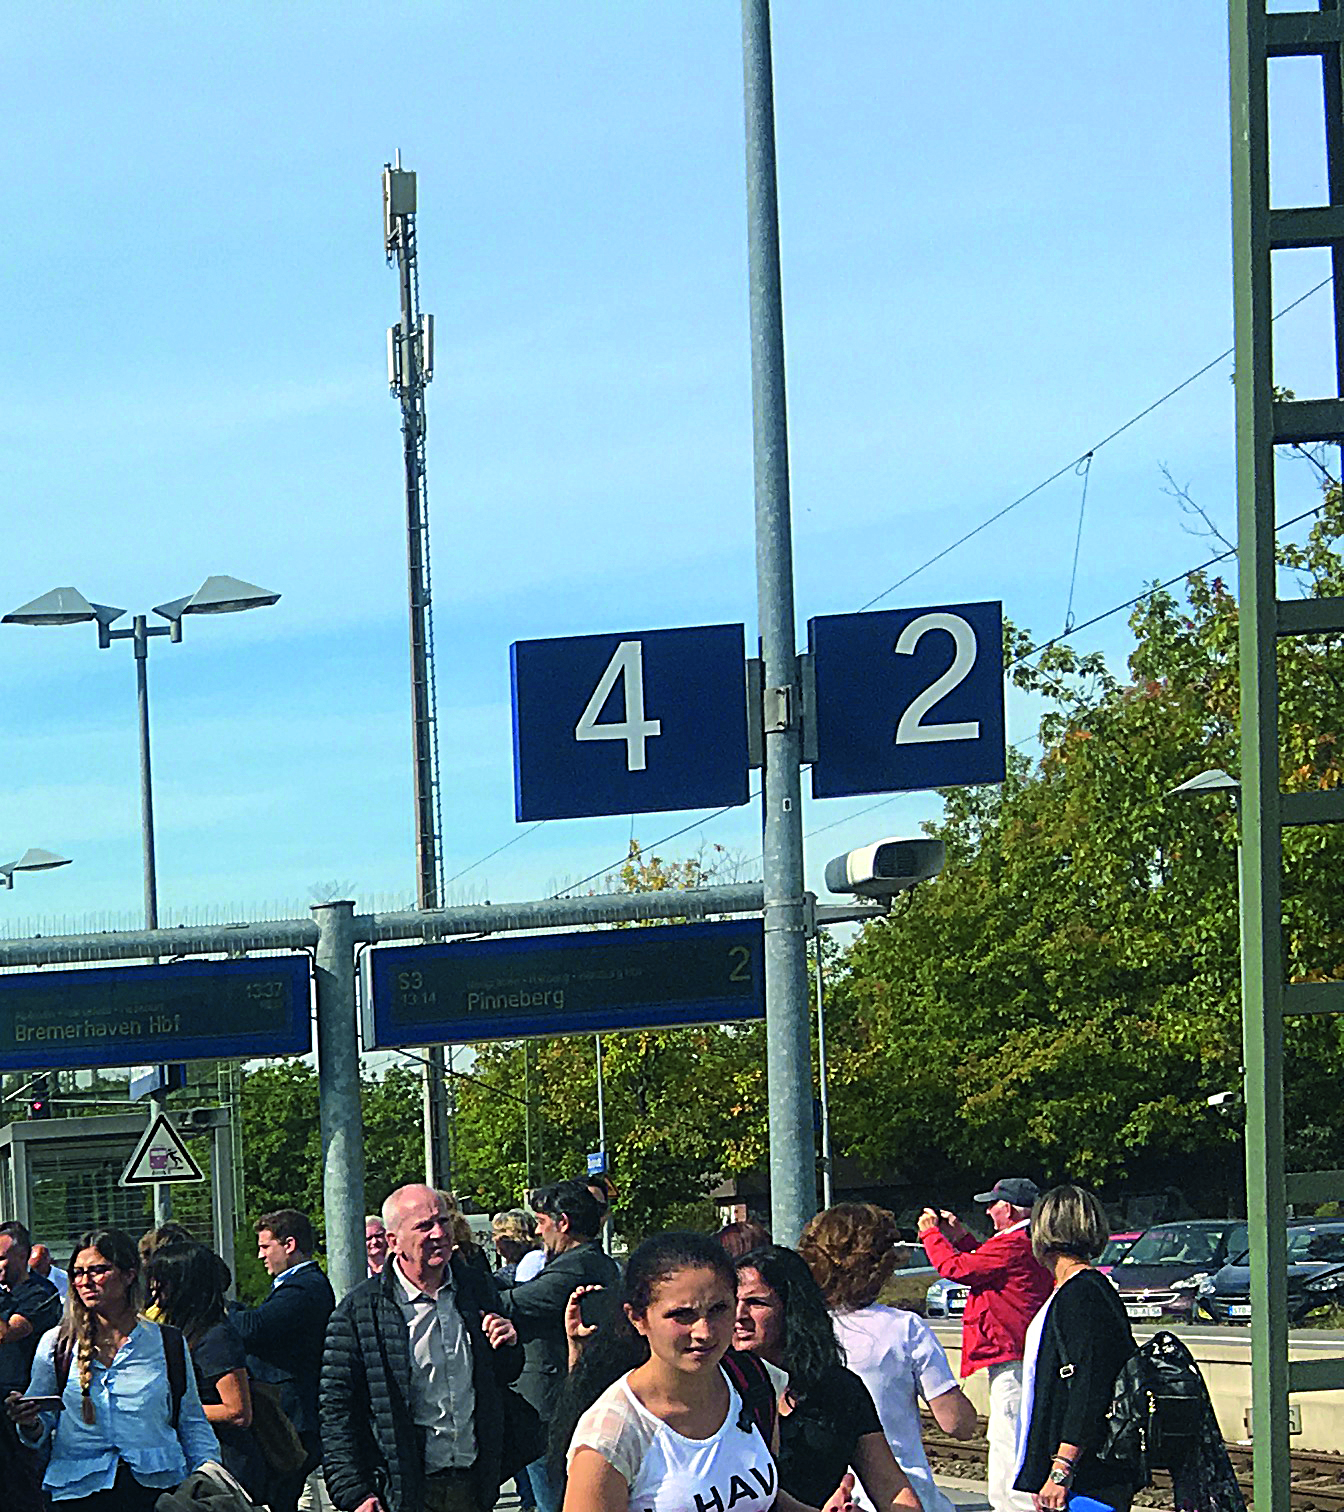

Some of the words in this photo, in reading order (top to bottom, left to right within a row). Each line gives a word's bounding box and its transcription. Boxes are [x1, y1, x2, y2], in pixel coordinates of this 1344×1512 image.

[893, 612, 980, 745] 2
[575, 640, 661, 771] 4
[727, 944, 752, 982] 2
[398, 971, 423, 990] S3
[467, 988, 565, 1012] Pinneberg
[14, 1019, 143, 1042] Bremerhaven
[149, 1014, 183, 1034] Hbf
